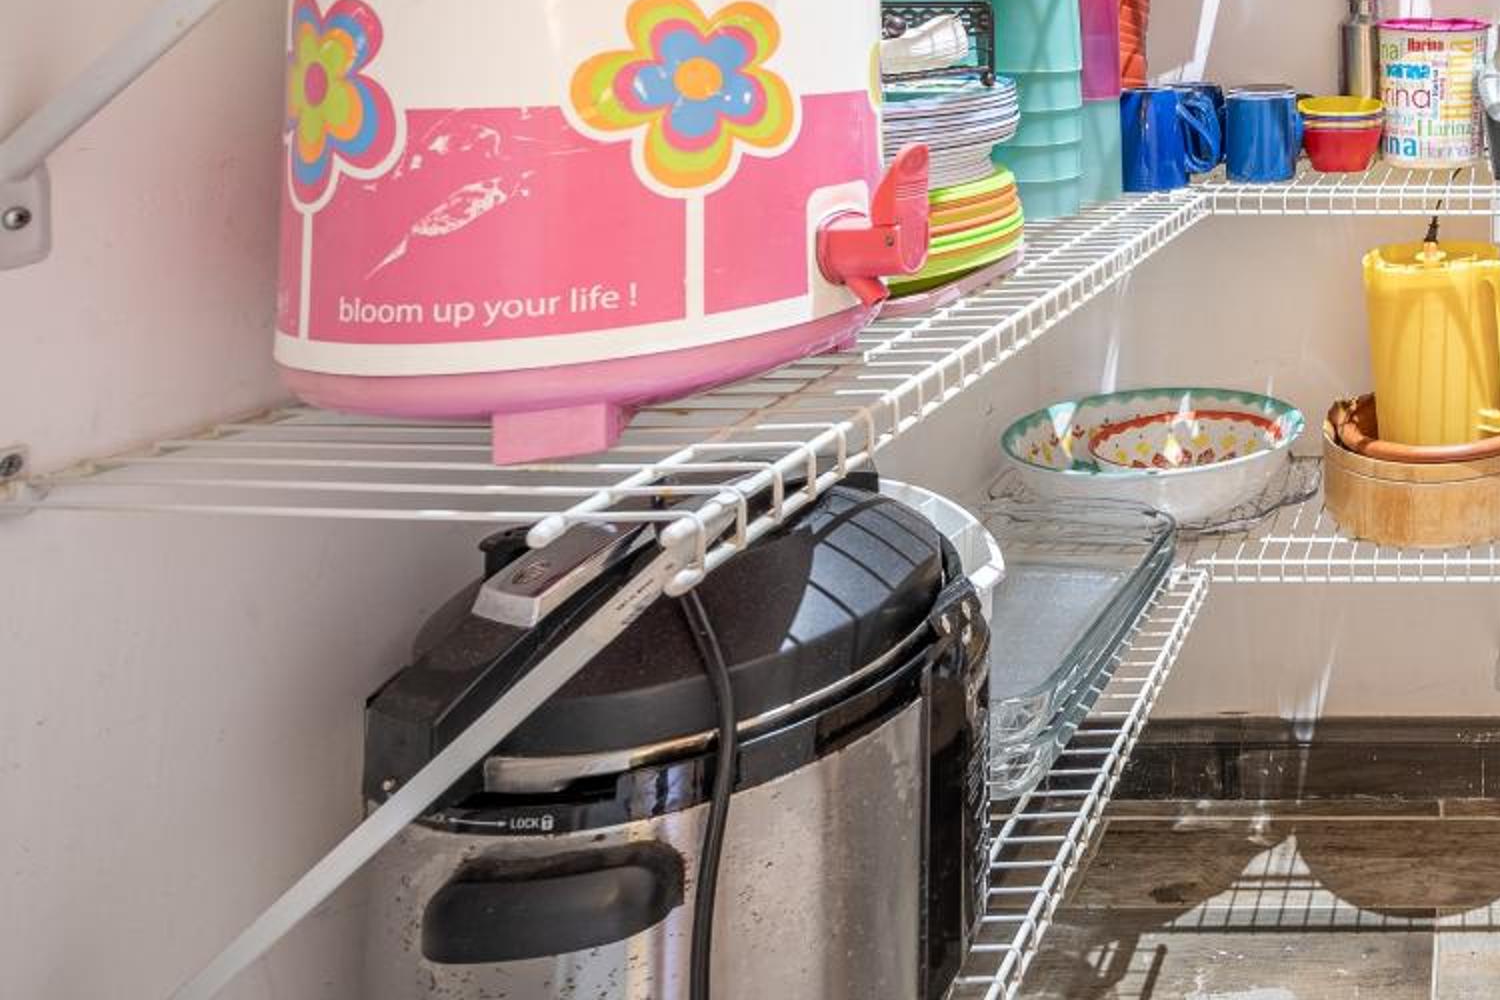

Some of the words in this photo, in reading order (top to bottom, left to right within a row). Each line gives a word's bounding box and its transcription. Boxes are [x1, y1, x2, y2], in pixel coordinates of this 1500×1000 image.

[339, 296, 423, 324] bloom
[433, 301, 474, 327] up
[483, 295, 560, 327] your
[570, 284, 619, 313] life
[628, 283, 638, 307] !
[509, 817, 541, 830] LOCK
